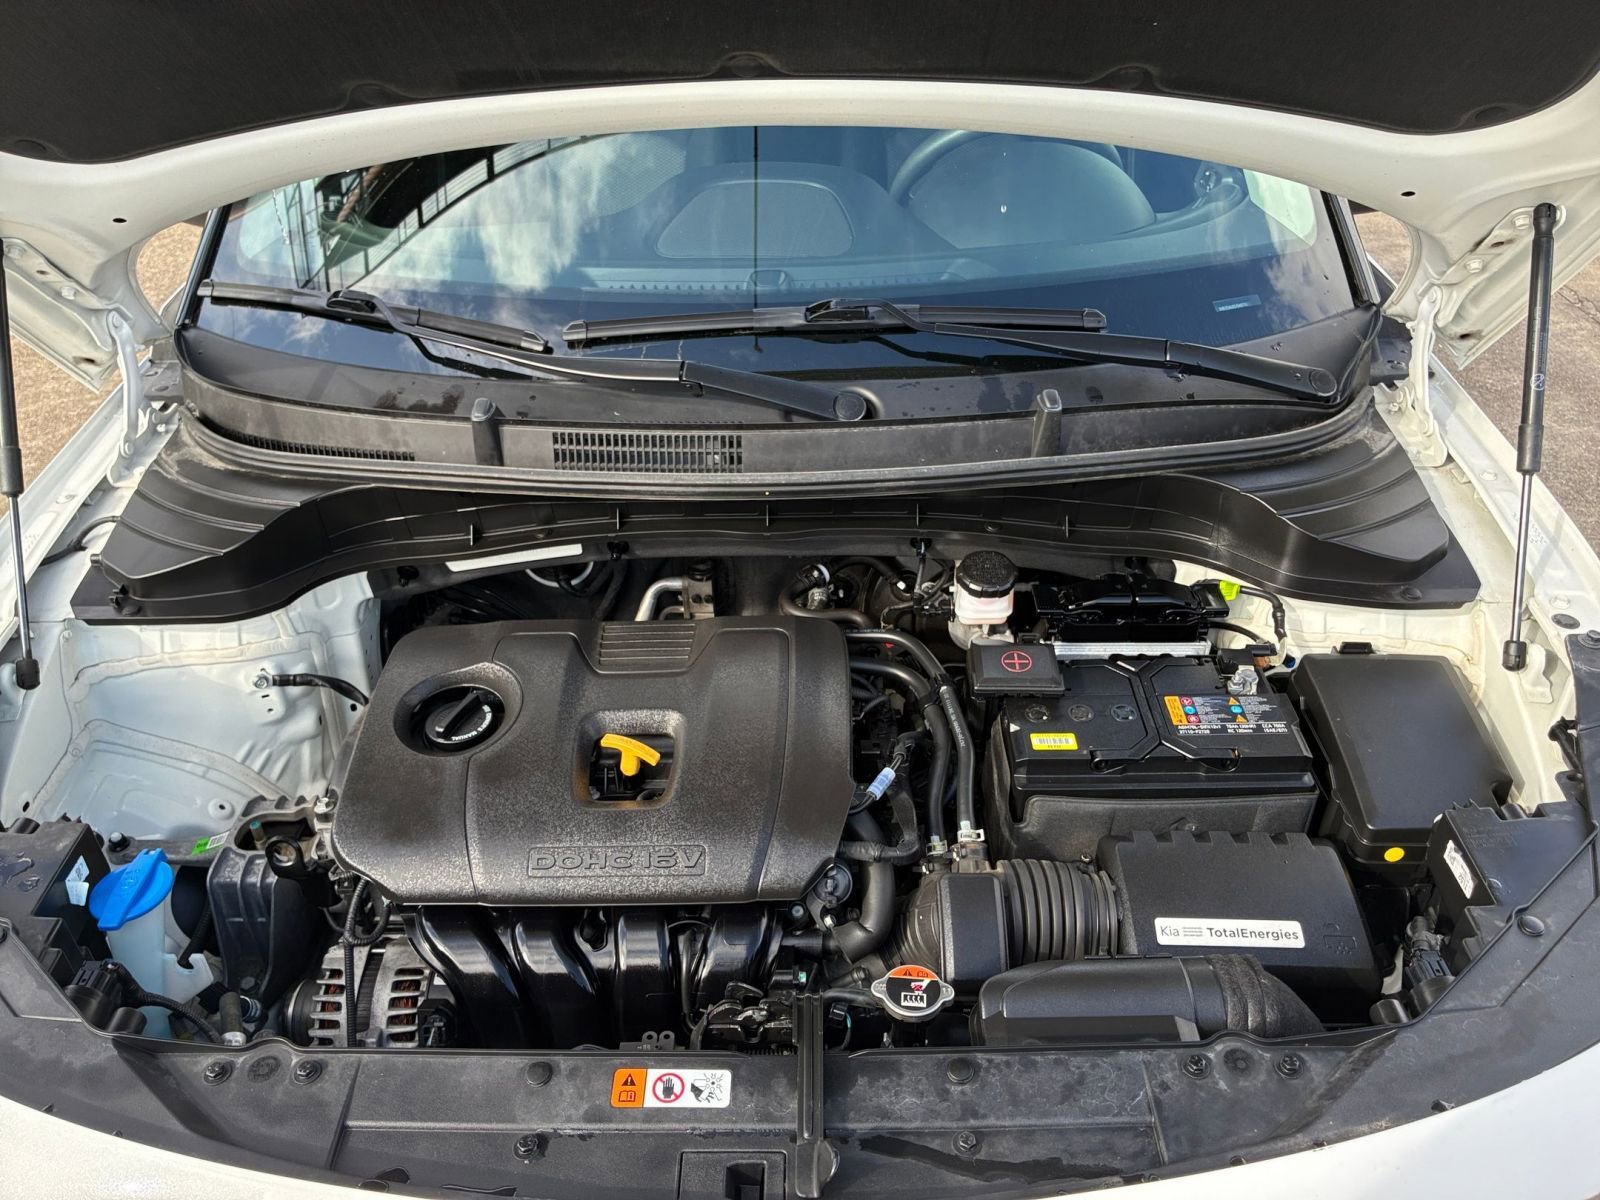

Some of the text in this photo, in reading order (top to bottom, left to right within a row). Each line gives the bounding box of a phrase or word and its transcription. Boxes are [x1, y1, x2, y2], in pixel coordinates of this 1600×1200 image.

[451, 731, 478, 741] MANUAL
[531, 850, 703, 870] DOHC 16V
[1160, 925, 1299, 941] Kia TotalEnergies
